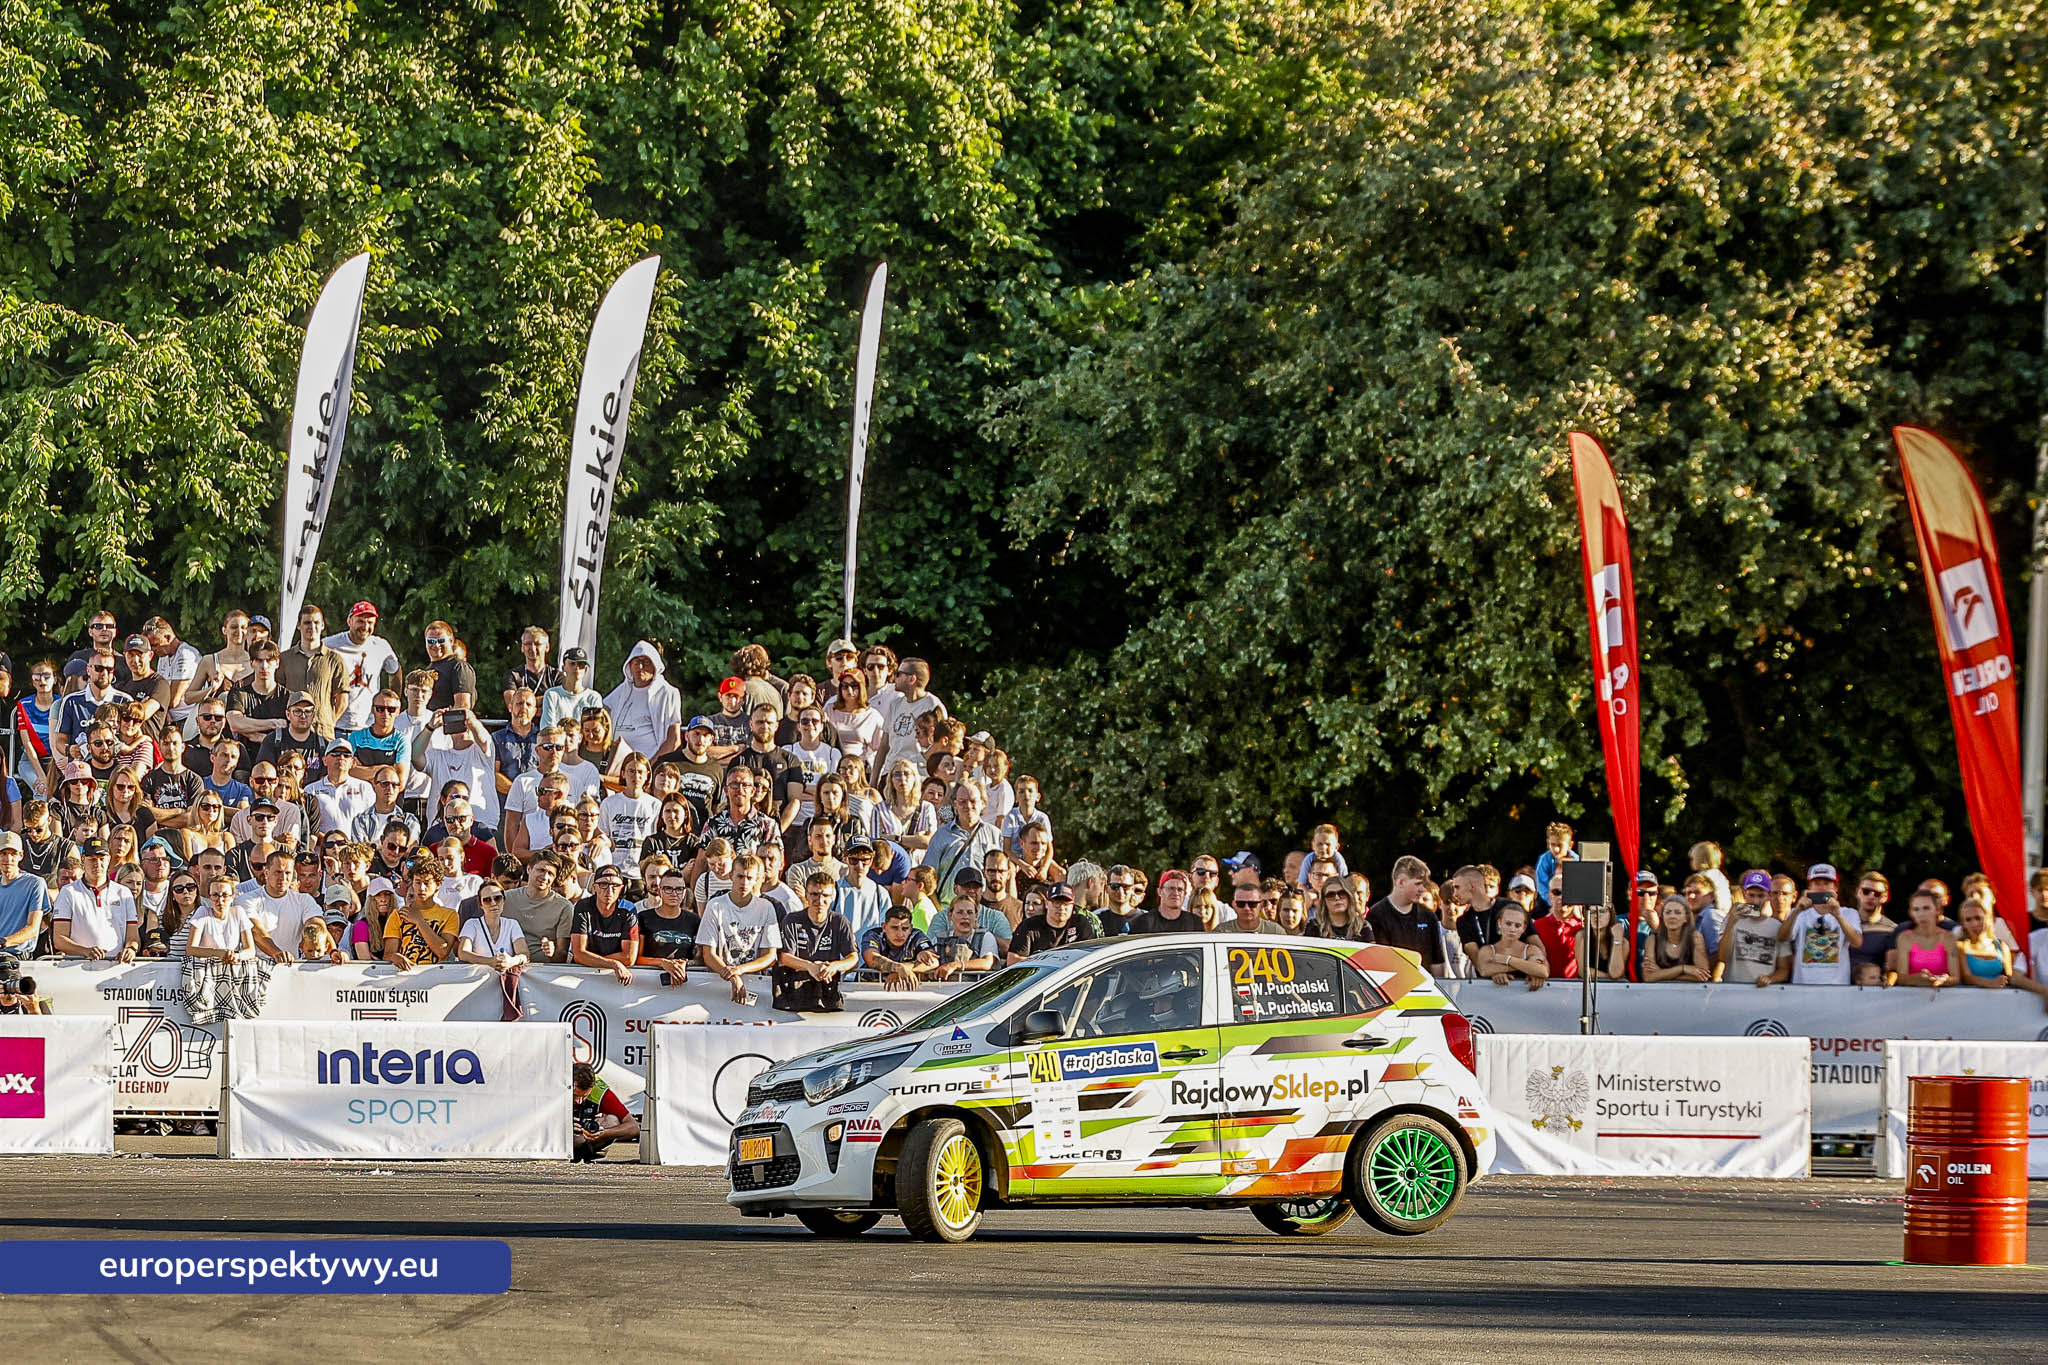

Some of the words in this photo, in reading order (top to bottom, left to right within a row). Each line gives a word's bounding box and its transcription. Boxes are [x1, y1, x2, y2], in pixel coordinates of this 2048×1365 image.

[1229, 948, 1295, 984] 240
[104, 988, 153, 1001] STADION
[156, 985, 184, 1006] ŚLĄS
[336, 990, 386, 1004] STADION
[389, 986, 429, 1008] ŚLĄSKI
[1250, 979, 1330, 996] W.Puchalski
[1255, 999, 1334, 1017] A.Puchalska
[119, 1065, 138, 1078] LAT
[318, 1042, 485, 1085] interia
[1029, 1052, 1061, 1083] 240
[1066, 1050, 1152, 1074] #rajdslaska
[118, 1081, 169, 1094] LEGENDY
[888, 1085, 939, 1096] TURN
[945, 1081, 982, 1092] ONE
[1172, 1070, 1370, 1109] RajdowySklep.pl
[1597, 1074, 1721, 1093] Ministerstwo
[348, 1099, 457, 1125] SPORT
[1596, 1099, 1659, 1119] Sportu
[1665, 1100, 1670, 1117] i
[1676, 1100, 1762, 1121] Turystyki
[1947, 1163, 1991, 1175] ORLEN
[1947, 1176, 1964, 1185] OIL
